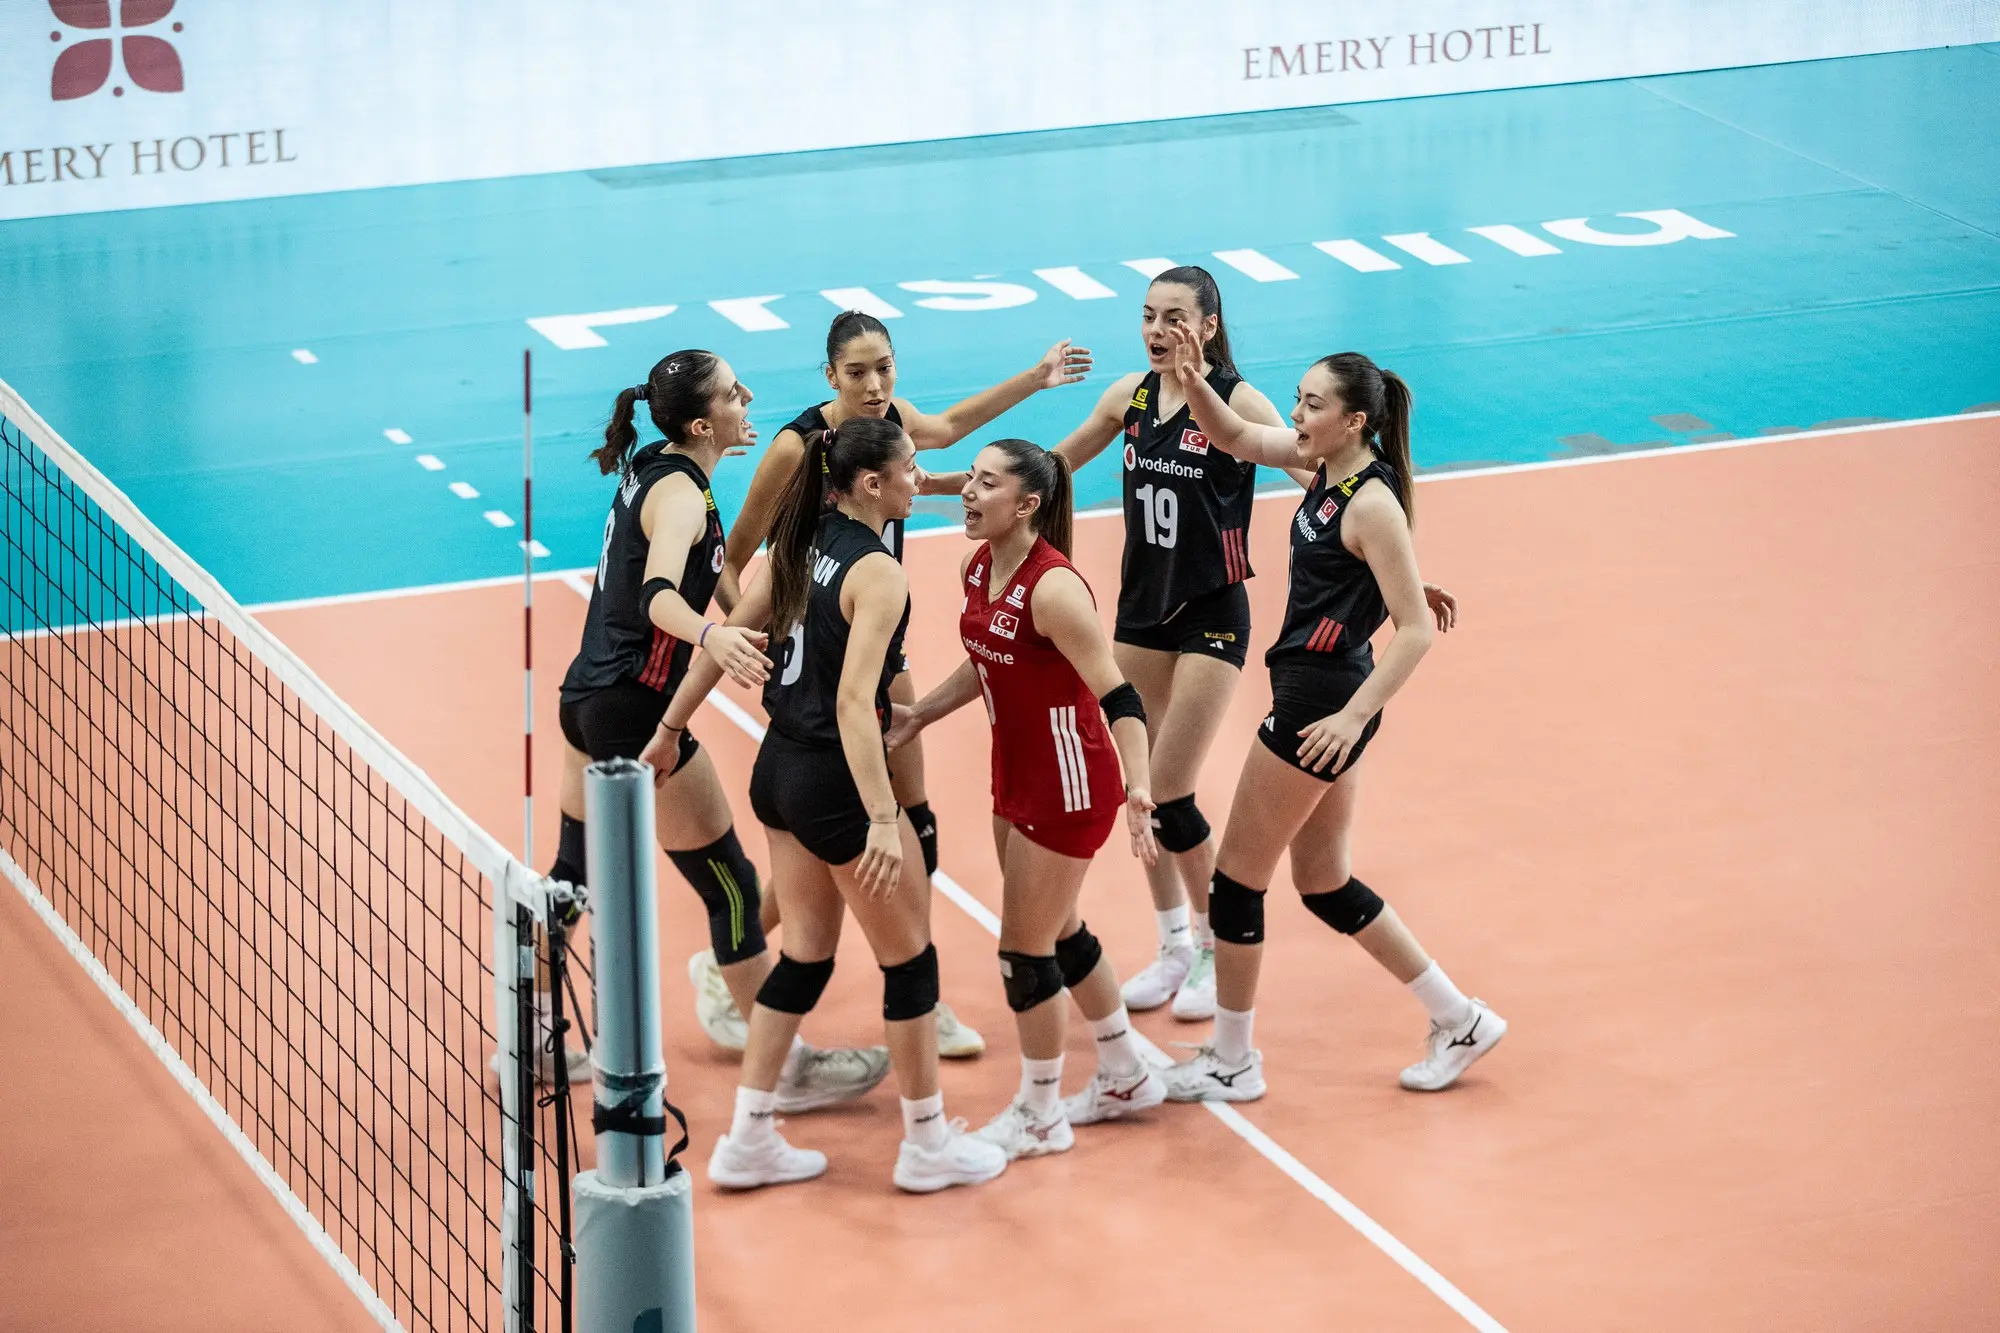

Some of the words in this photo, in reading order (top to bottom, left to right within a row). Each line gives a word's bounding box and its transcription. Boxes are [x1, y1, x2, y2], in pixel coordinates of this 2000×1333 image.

[1240, 36, 1394, 81] EMERY
[1407, 22, 1552, 66] HOTEL
[131, 128, 298, 176] HOTEL
[1185, 444, 1201, 453] TUR
[1137, 456, 1204, 479] vodafone
[1136, 483, 1179, 549] 19
[994, 626, 1009, 637] TUR
[963, 636, 1014, 665] vodafone
